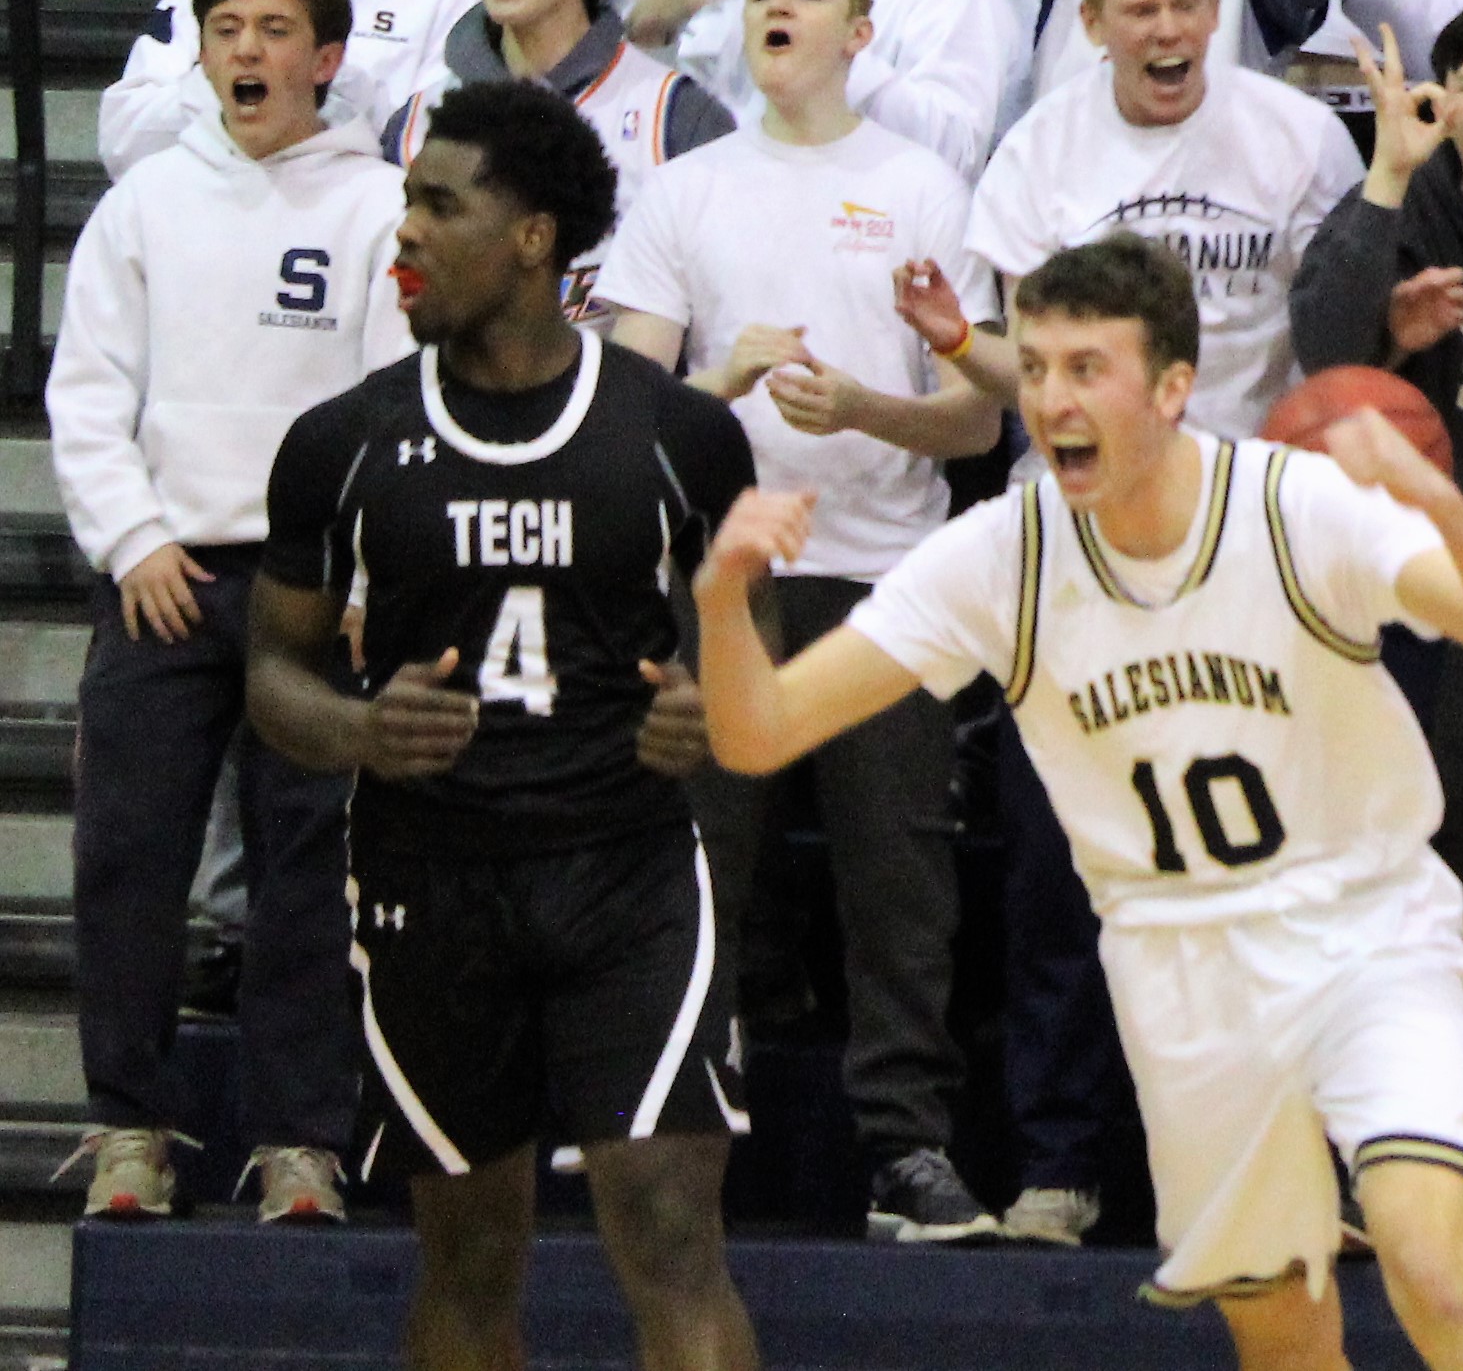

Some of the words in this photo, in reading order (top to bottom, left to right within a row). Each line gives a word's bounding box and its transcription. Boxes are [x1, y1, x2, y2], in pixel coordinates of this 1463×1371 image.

[374, 11, 394, 33] S
[276, 248, 330, 312] S
[446, 499, 573, 567] TECH
[479, 585, 558, 718] 4
[1069, 650, 1293, 734] SALESIANUM
[1131, 753, 1287, 873] 10
